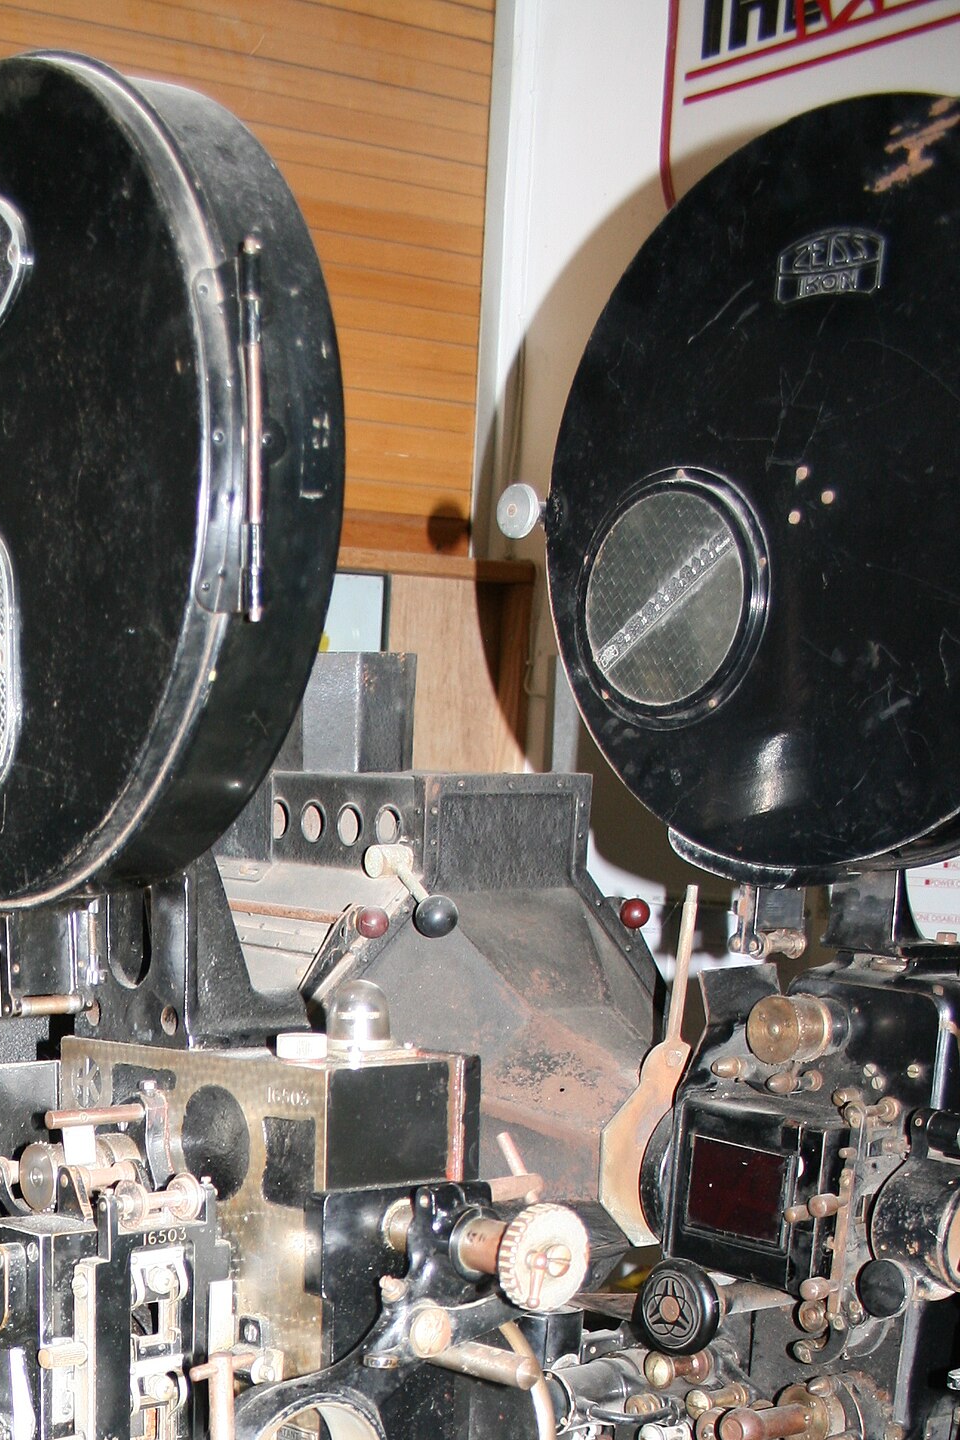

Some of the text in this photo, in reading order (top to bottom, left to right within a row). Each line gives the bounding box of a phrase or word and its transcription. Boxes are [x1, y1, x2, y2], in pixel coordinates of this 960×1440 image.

[792, 232, 869, 274] ZEISS
[797, 268, 859, 299] IKON
[267, 1085, 310, 1106] 16503
[142, 1226, 187, 1246] 16503
